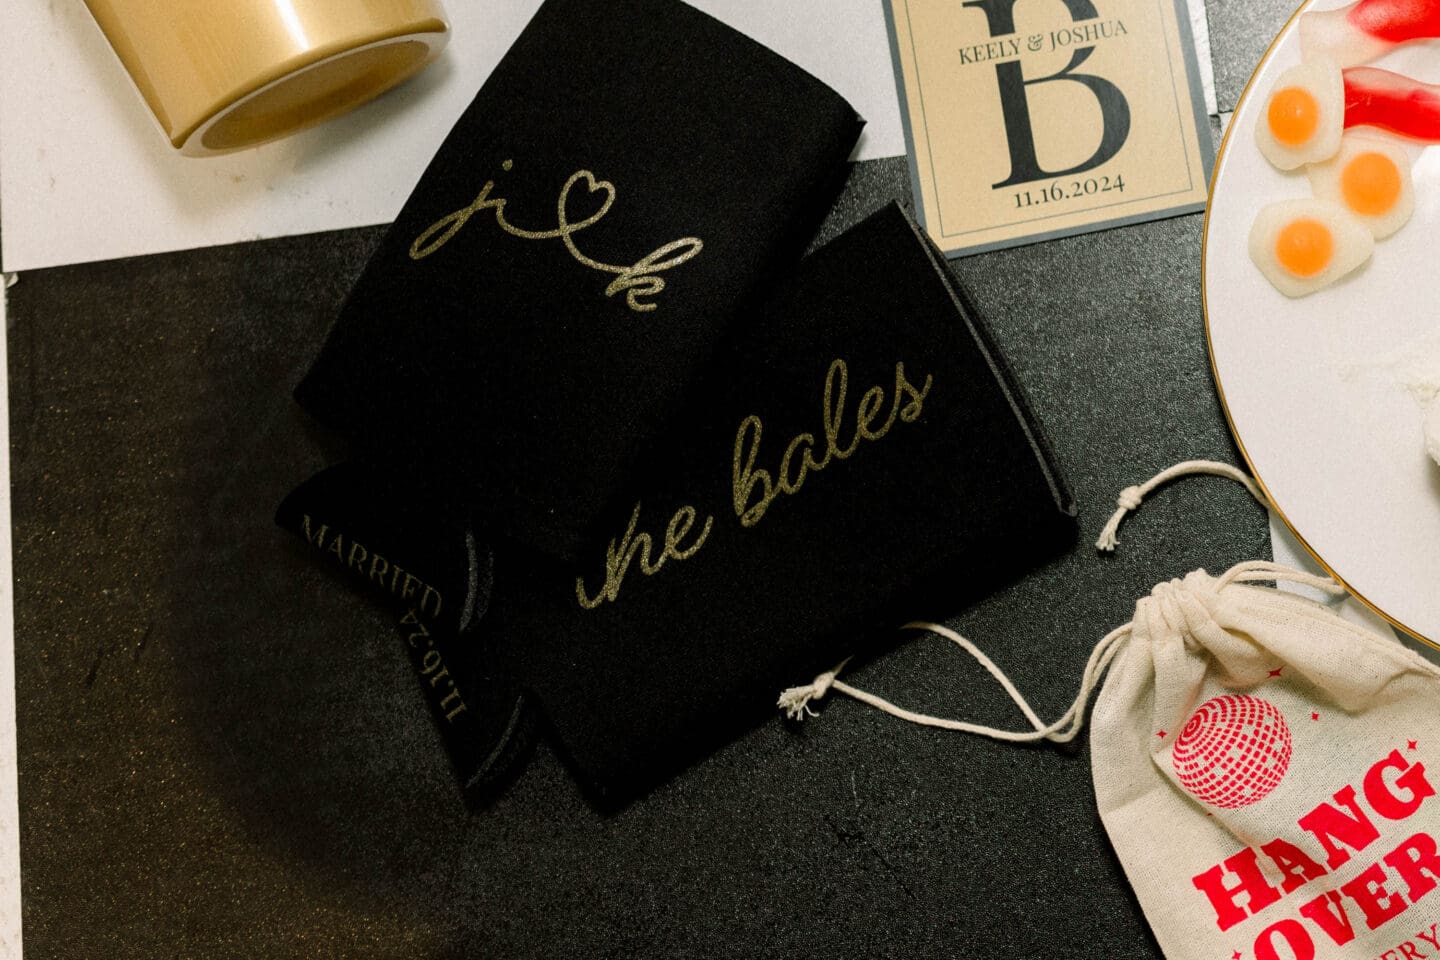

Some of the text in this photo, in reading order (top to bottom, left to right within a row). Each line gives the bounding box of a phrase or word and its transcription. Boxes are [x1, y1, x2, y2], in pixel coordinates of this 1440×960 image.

[959, 20, 1129, 65] KEELY & JOSHUA
[1014, 174, 1126, 209] 11.16.2024
[732, 358, 934, 528] bales
[302, 514, 443, 617] MARRIED
[1191, 748, 1436, 932] HANG
